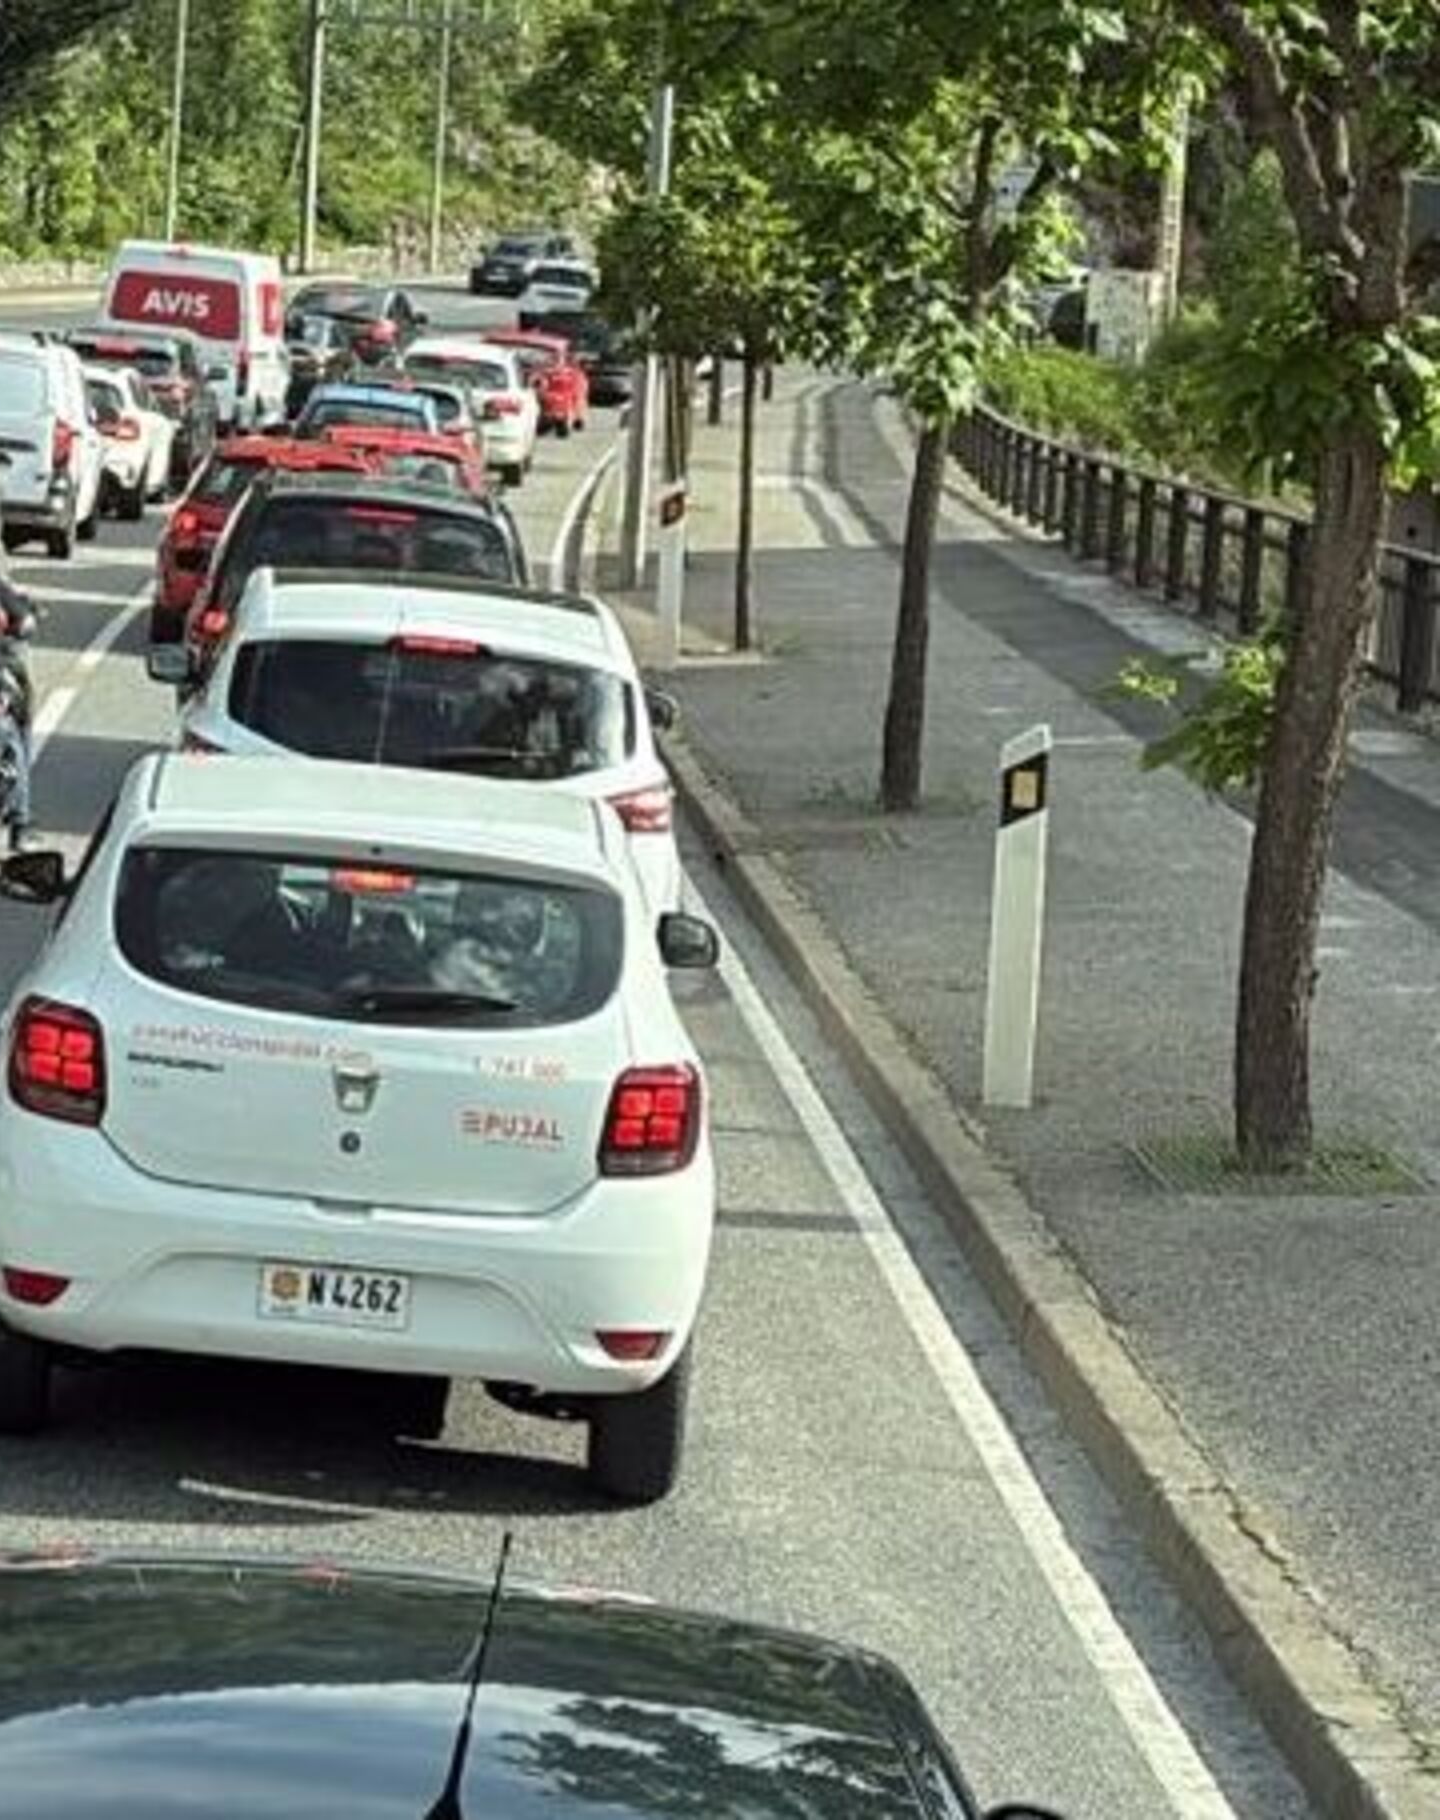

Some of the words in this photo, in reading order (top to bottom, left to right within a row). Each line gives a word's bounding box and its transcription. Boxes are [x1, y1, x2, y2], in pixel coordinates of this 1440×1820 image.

[141, 288, 210, 318] AVIS
[308, 1270, 327, 1306] N
[331, 1273, 402, 1313] 4262
